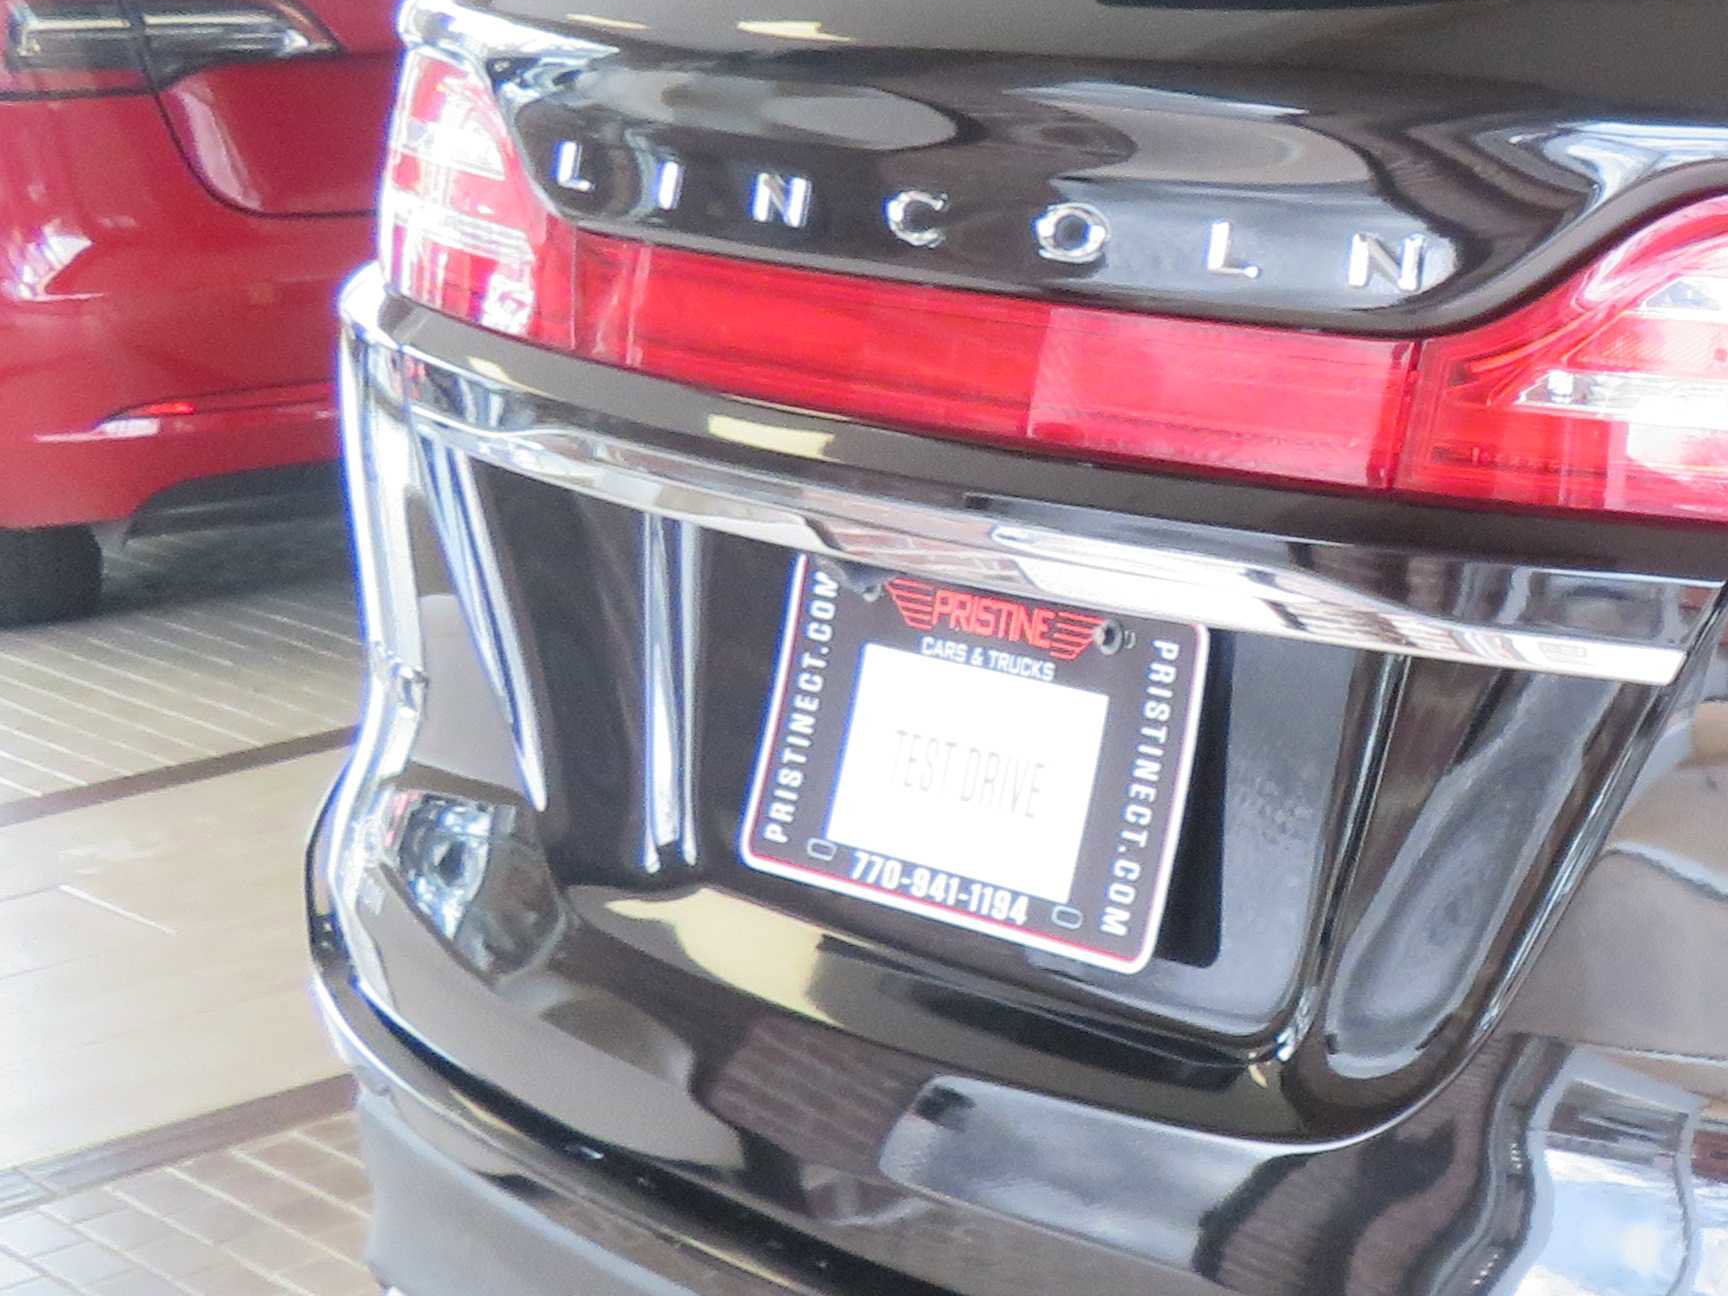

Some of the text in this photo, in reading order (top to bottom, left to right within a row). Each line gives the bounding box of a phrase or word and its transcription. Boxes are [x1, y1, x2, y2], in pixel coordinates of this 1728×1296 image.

[555, 139, 1428, 292] LINCOLN
[921, 635, 1055, 681] CARS & TRUCKS
[932, 589, 1055, 649] PRISTINE
[762, 571, 841, 843] PRISTINECT.COM
[890, 729, 1046, 818] TEST DRIVE
[1101, 638, 1181, 937] PRISTINECT.COM
[850, 850, 1030, 925] 770-941-1194
